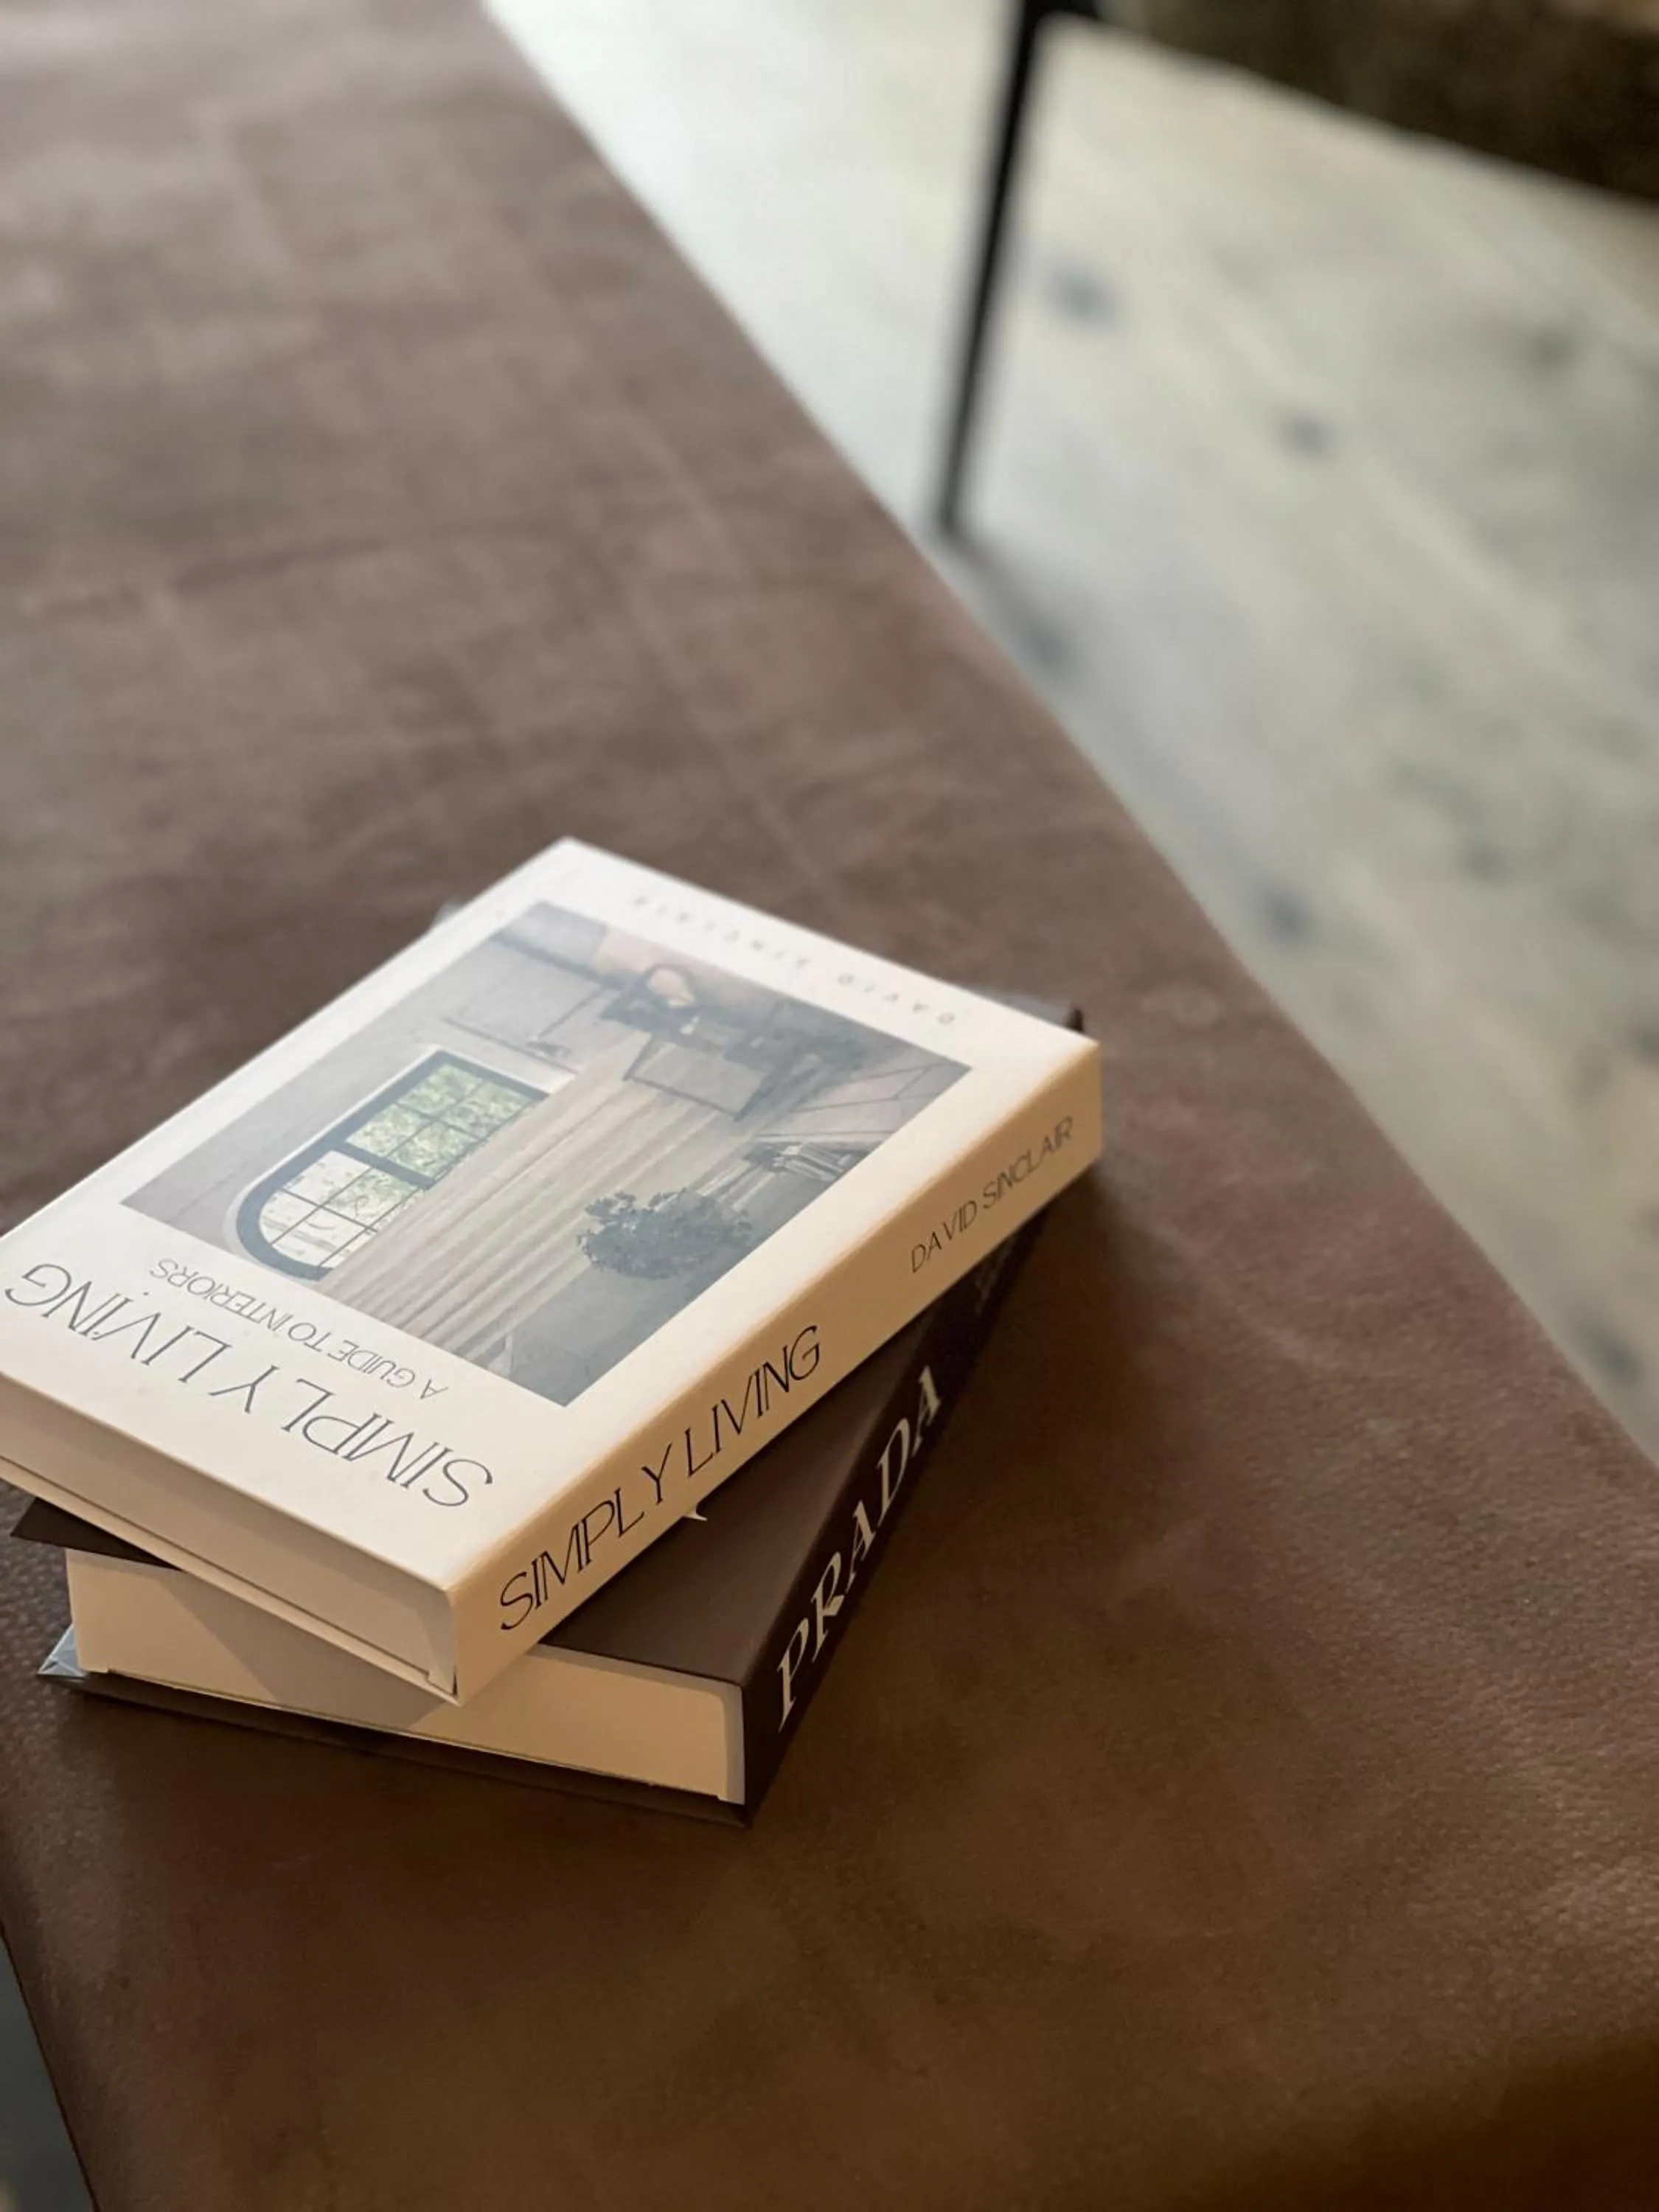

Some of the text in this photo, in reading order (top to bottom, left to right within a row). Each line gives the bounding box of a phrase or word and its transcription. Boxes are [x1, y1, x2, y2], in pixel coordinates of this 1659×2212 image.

[911, 1114, 1074, 1274] DAVID SINCLAIR
[4, 1262, 493, 1507] SIMPLY LIVING
[149, 1257, 450, 1400] A GUIDE TO INTERIORS
[499, 1324, 820, 1631] SIMPLY LIVING
[776, 1364, 942, 1734] PRADA
